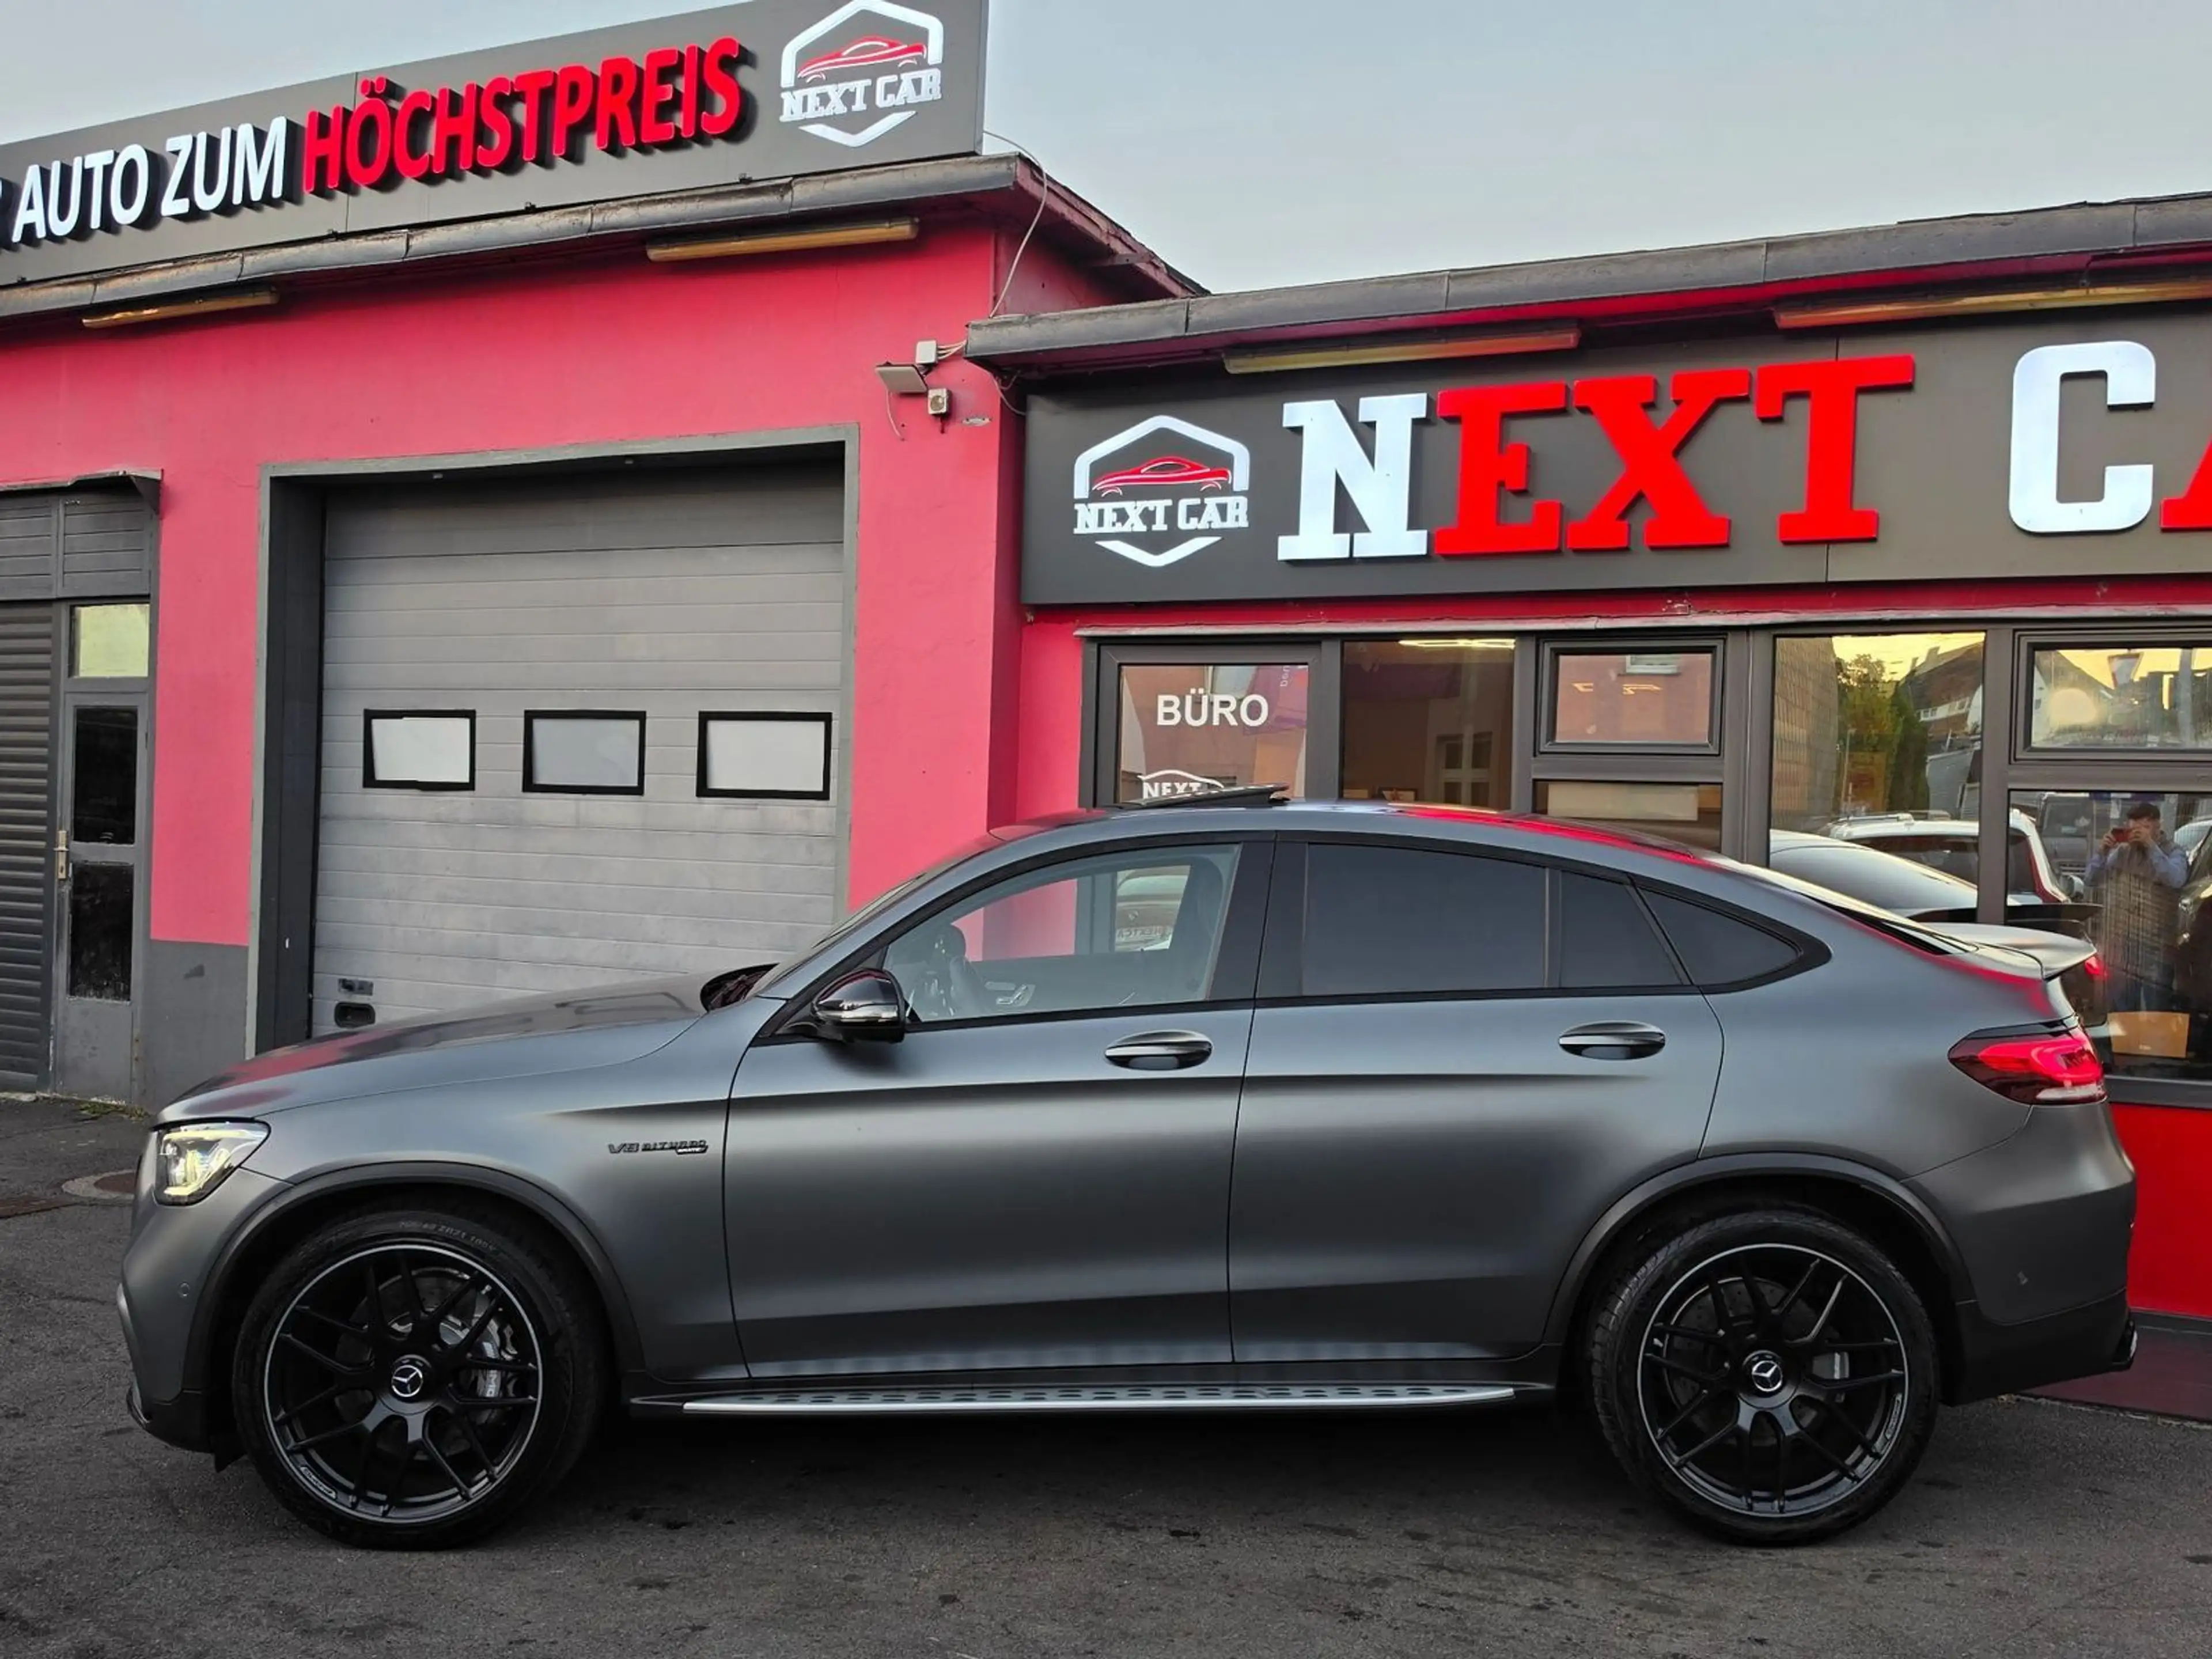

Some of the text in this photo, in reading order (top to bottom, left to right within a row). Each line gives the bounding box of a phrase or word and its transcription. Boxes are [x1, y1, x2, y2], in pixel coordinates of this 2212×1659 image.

[779, 67, 942, 123] NEXT CAR
[12, 37, 740, 243] AUTO ZUM HÖCHSTPREIS
[1278, 355, 1914, 560] NEXT
[1073, 495, 1249, 535] NEXT CAR
[1156, 687, 1269, 727] BÜRO
